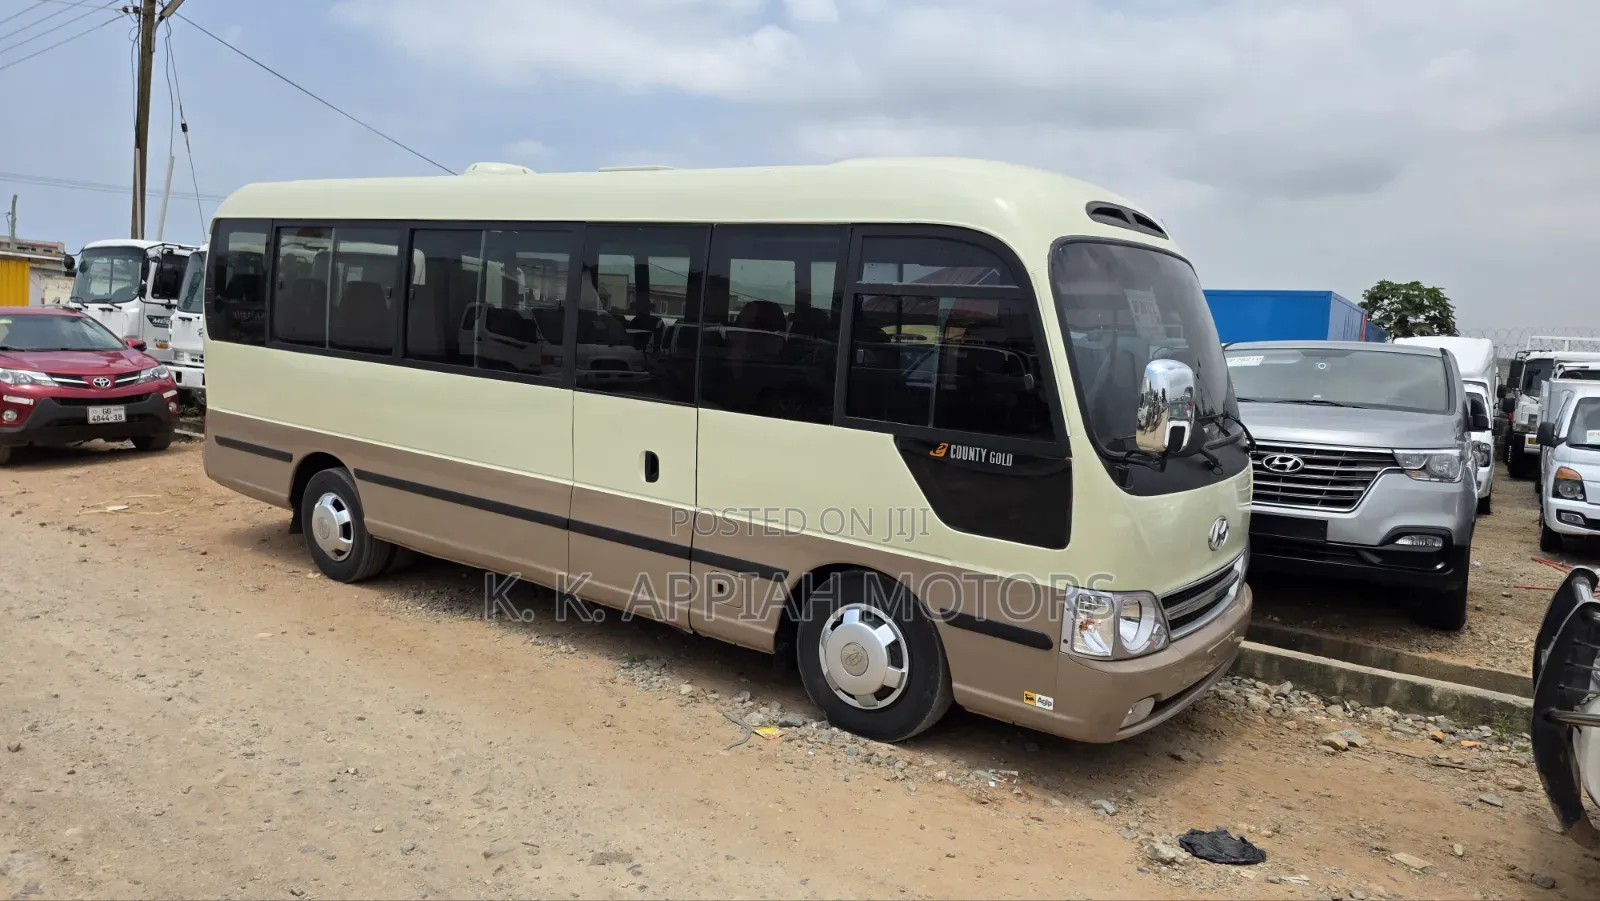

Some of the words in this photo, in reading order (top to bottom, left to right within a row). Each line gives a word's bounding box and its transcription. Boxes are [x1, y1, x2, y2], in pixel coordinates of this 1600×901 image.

[950, 444, 987, 462] COUNTY
[989, 451, 1013, 466] GOLD
[1037, 696, 1053, 707] Agip
